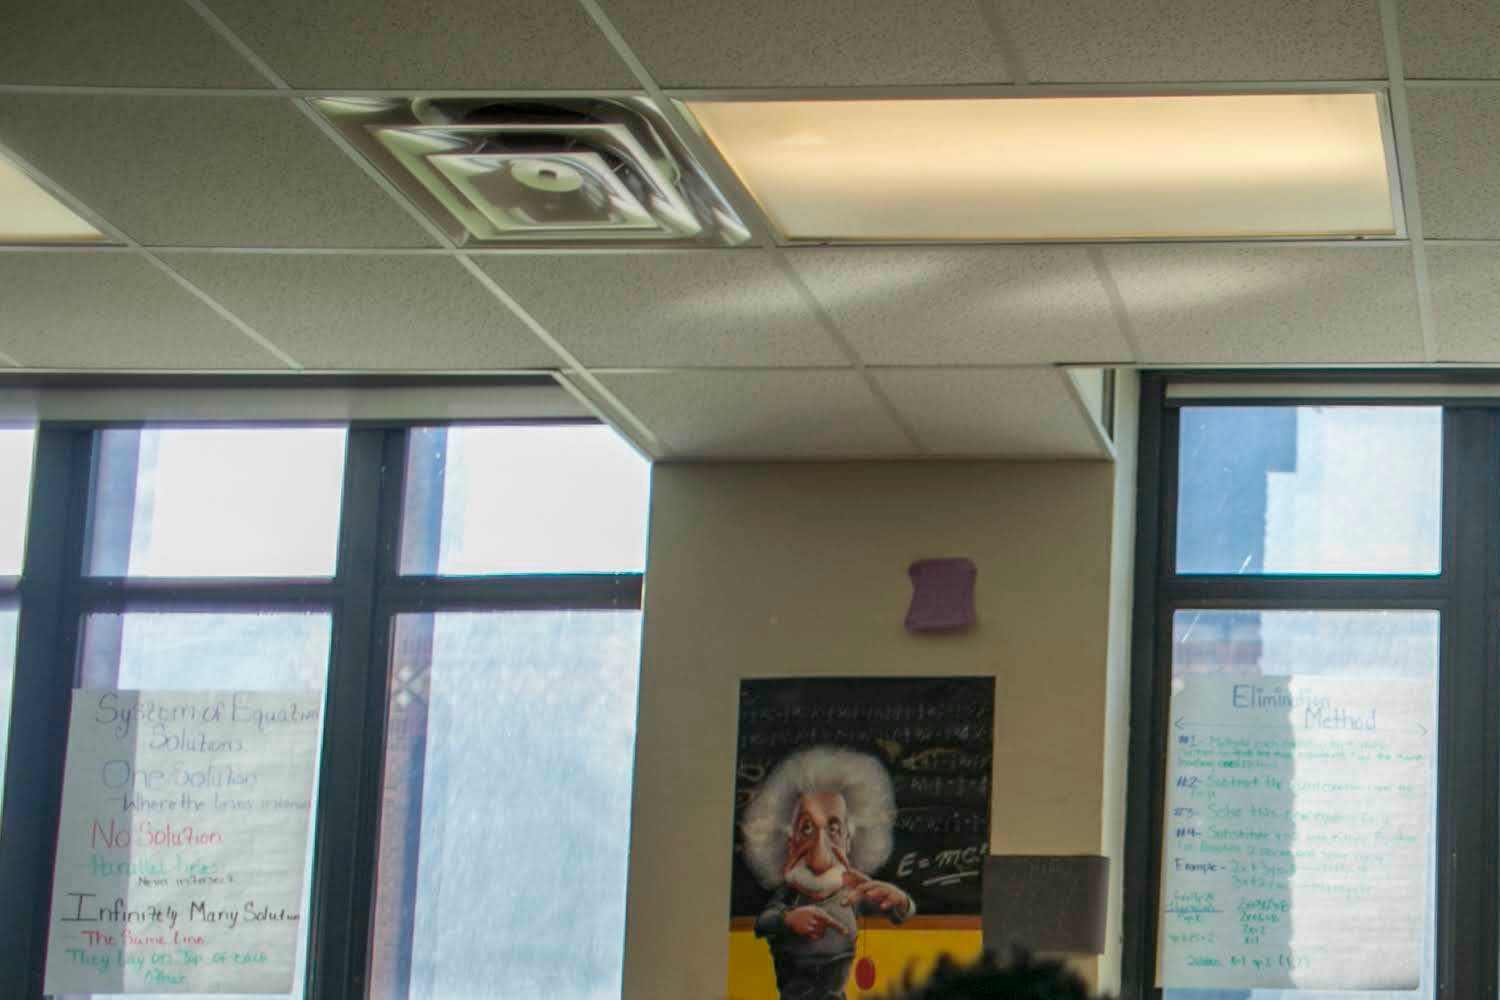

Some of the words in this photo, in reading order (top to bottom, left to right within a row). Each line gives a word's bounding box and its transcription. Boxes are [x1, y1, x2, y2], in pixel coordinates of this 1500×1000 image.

[1304, 707, 1376, 731] Method
[102, 759, 164, 790] One
[92, 819, 131, 849] No
[61, 892, 178, 928] Infinitely
[190, 901, 239, 928] Many
